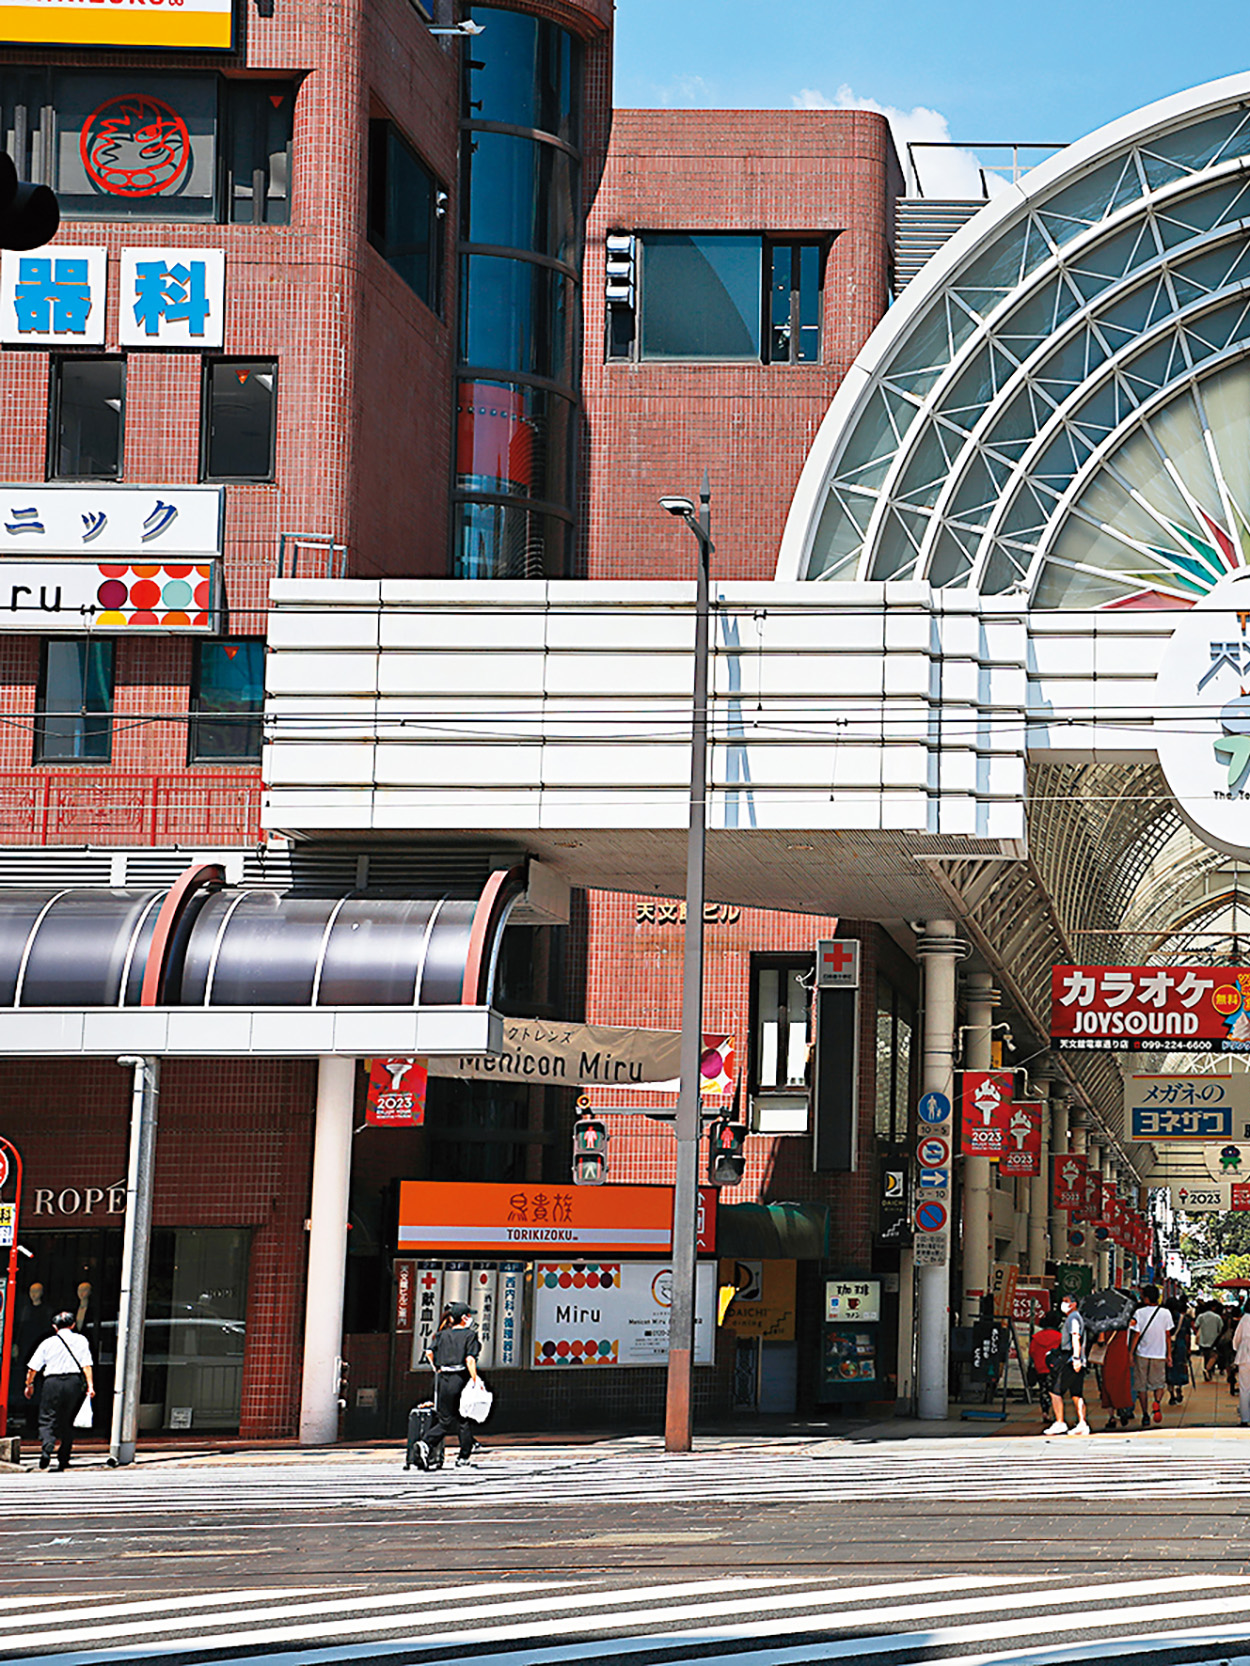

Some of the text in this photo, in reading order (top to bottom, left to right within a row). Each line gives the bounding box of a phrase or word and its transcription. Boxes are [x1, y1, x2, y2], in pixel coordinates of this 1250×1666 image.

[1213, 790, 1233, 800] The
[1060, 971, 1214, 1007] カラオケ
[1216, 994, 1239, 1006] 無料
[1073, 1011, 1199, 1035] JOYSOUND
[1141, 1041, 1213, 1050] 099-224-6600
[579, 1052, 643, 1083] Miru
[1142, 1082, 1226, 1104] メガネの
[377, 1097, 413, 1109] 2023
[1140, 1112, 1225, 1134] ヨネザワ
[971, 1132, 1002, 1143] 2023
[1007, 1154, 1034, 1166] 2023
[34, 1177, 127, 1216] ROPÉ
[1190, 1194, 1221, 1205] 2023
[507, 1228, 573, 1242] TORIKIZOKU
[555, 1306, 601, 1324] Miru
[418, 1291, 437, 1365] 献血ルーム
